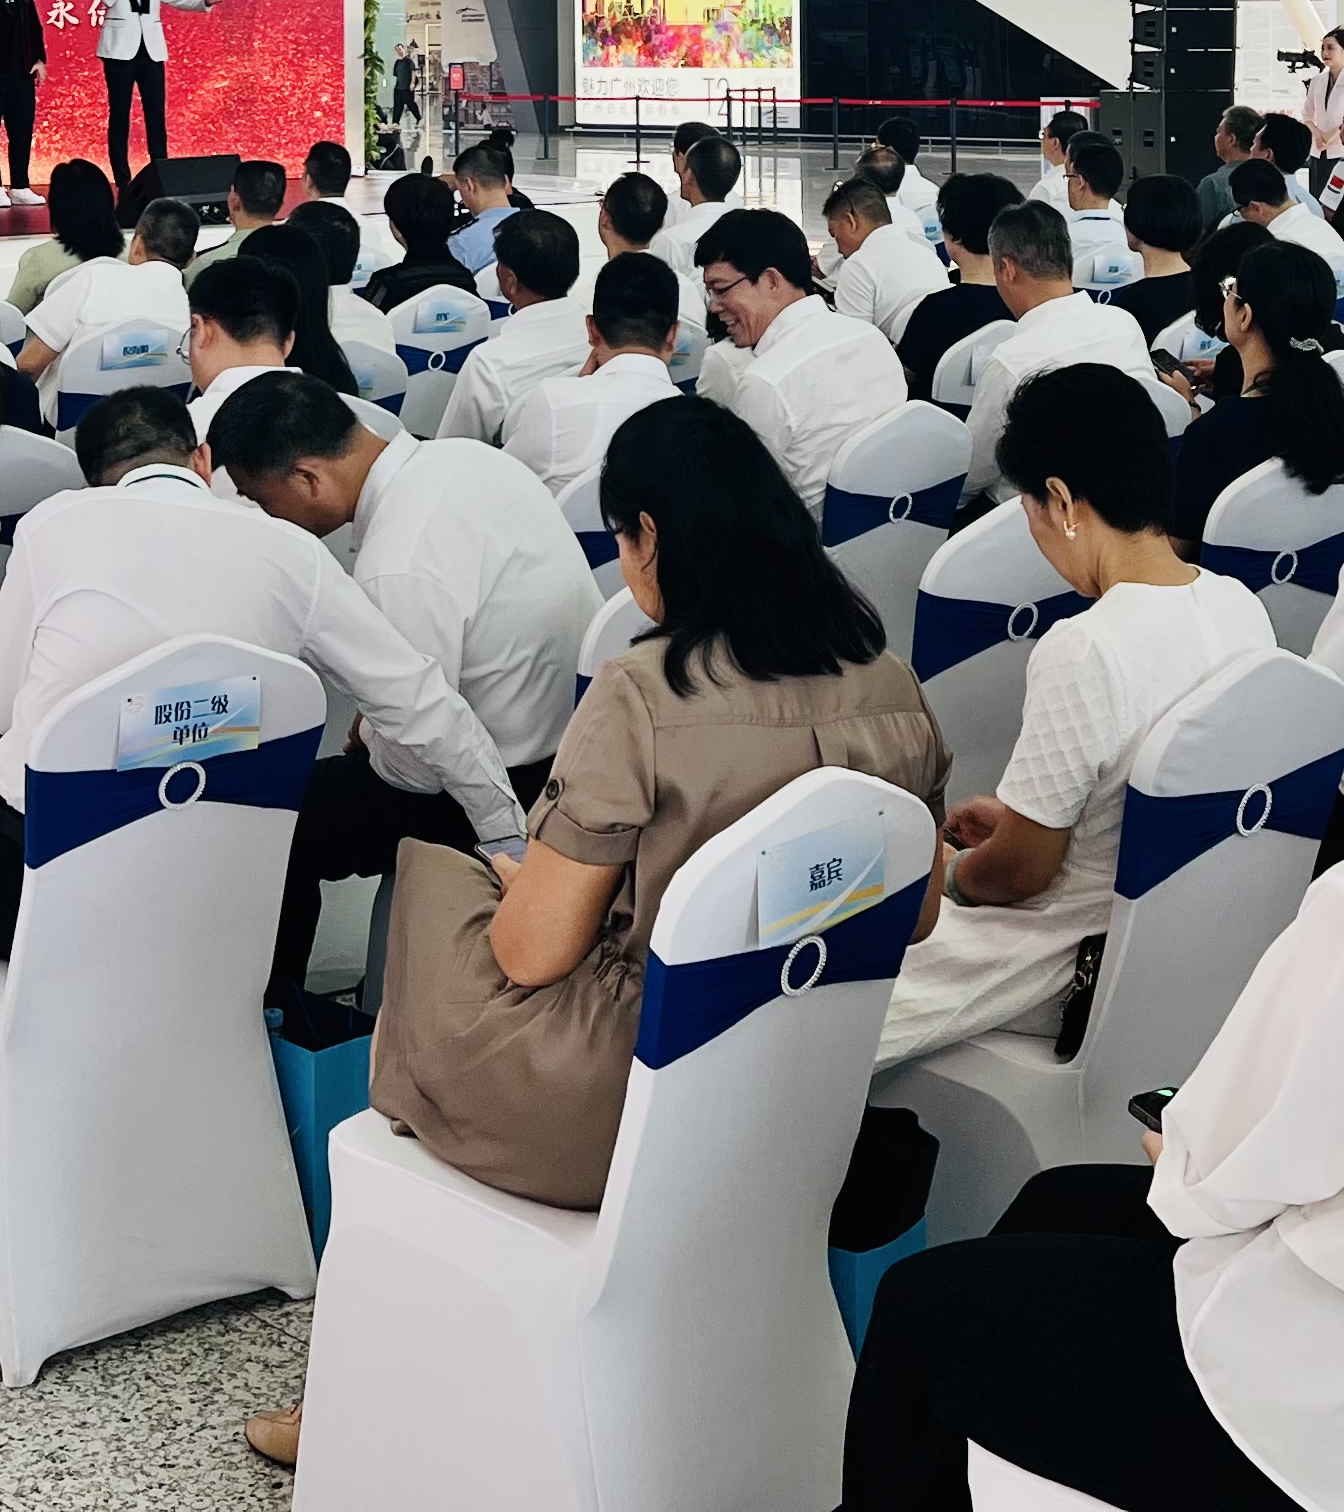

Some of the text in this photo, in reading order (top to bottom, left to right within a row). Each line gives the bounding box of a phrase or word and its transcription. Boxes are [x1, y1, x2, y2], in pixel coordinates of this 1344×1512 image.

[582, 77, 680, 96] 魅力广州欢迎您
[154, 694, 229, 726] 股份二级
[172, 721, 210, 746] 单位
[809, 857, 844, 892] 嘉宾
